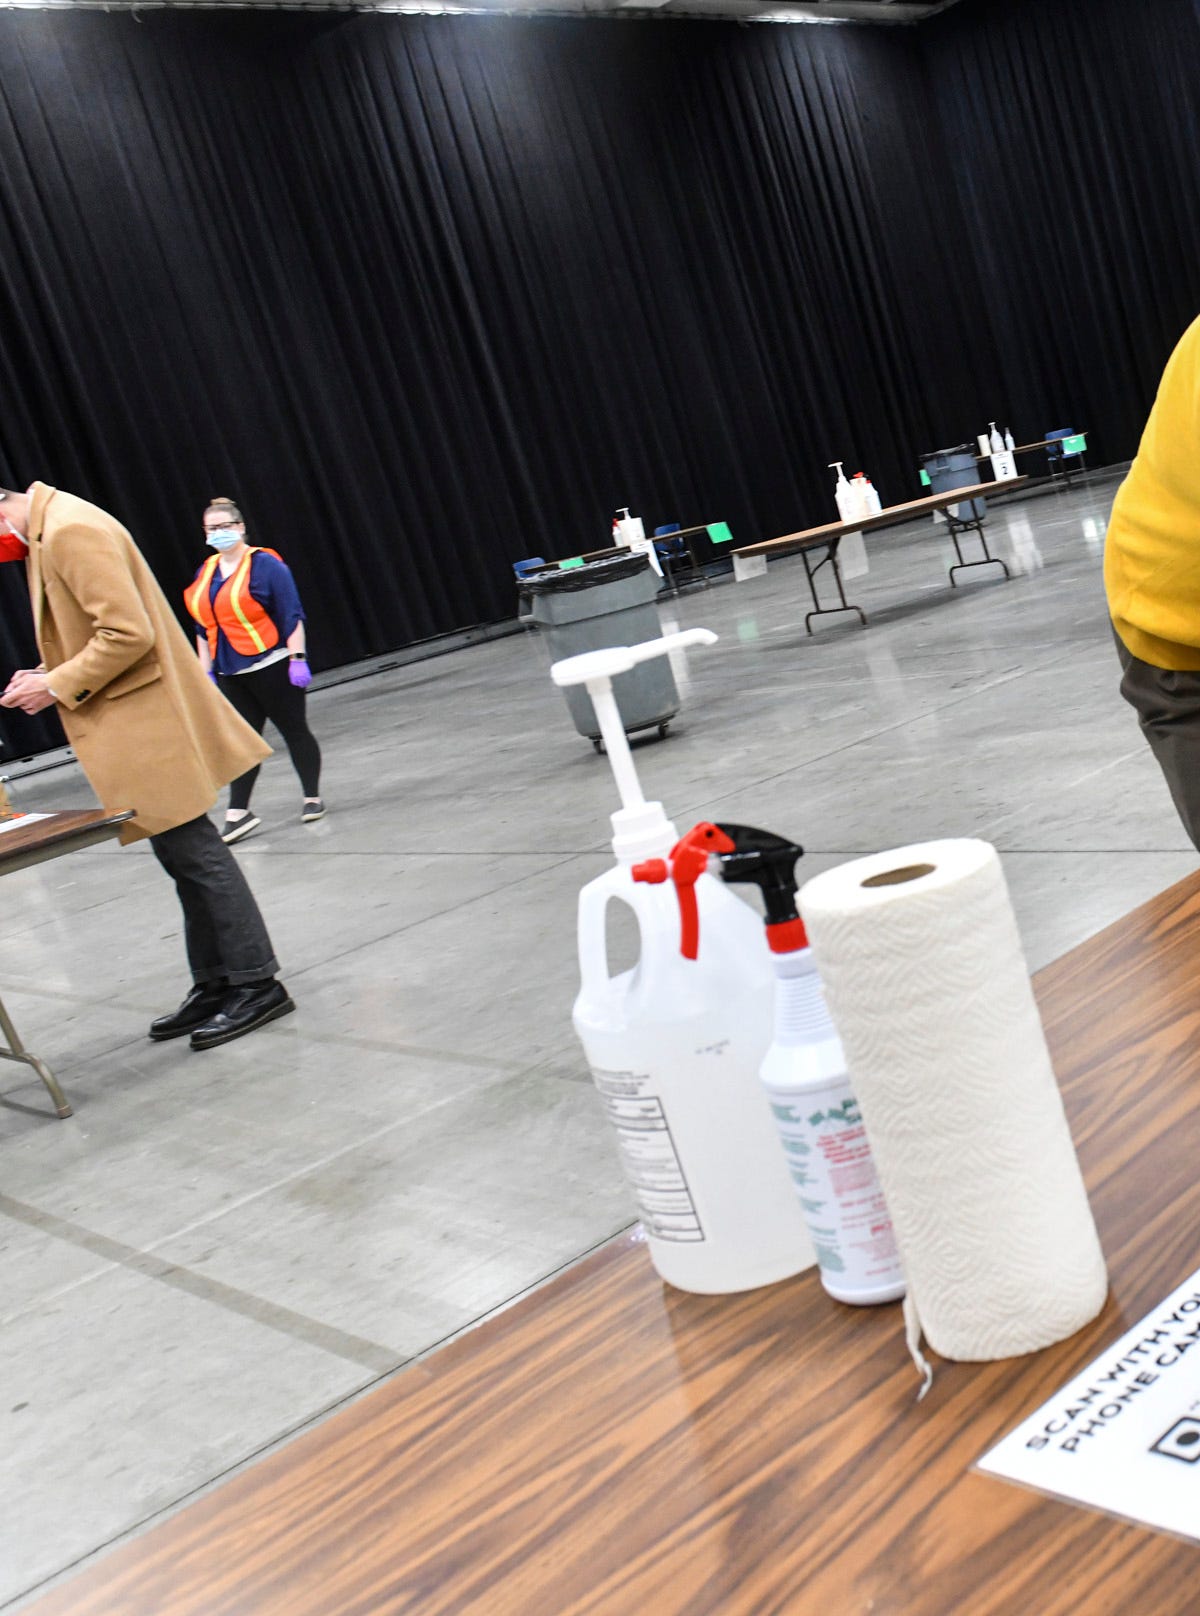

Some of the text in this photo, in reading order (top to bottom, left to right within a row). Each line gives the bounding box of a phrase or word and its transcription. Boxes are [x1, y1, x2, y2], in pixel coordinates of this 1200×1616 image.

[1026, 1388, 1103, 1450] SCAN
[1098, 1329, 1170, 1383] WITH
[1060, 1371, 1160, 1453] PHONE
